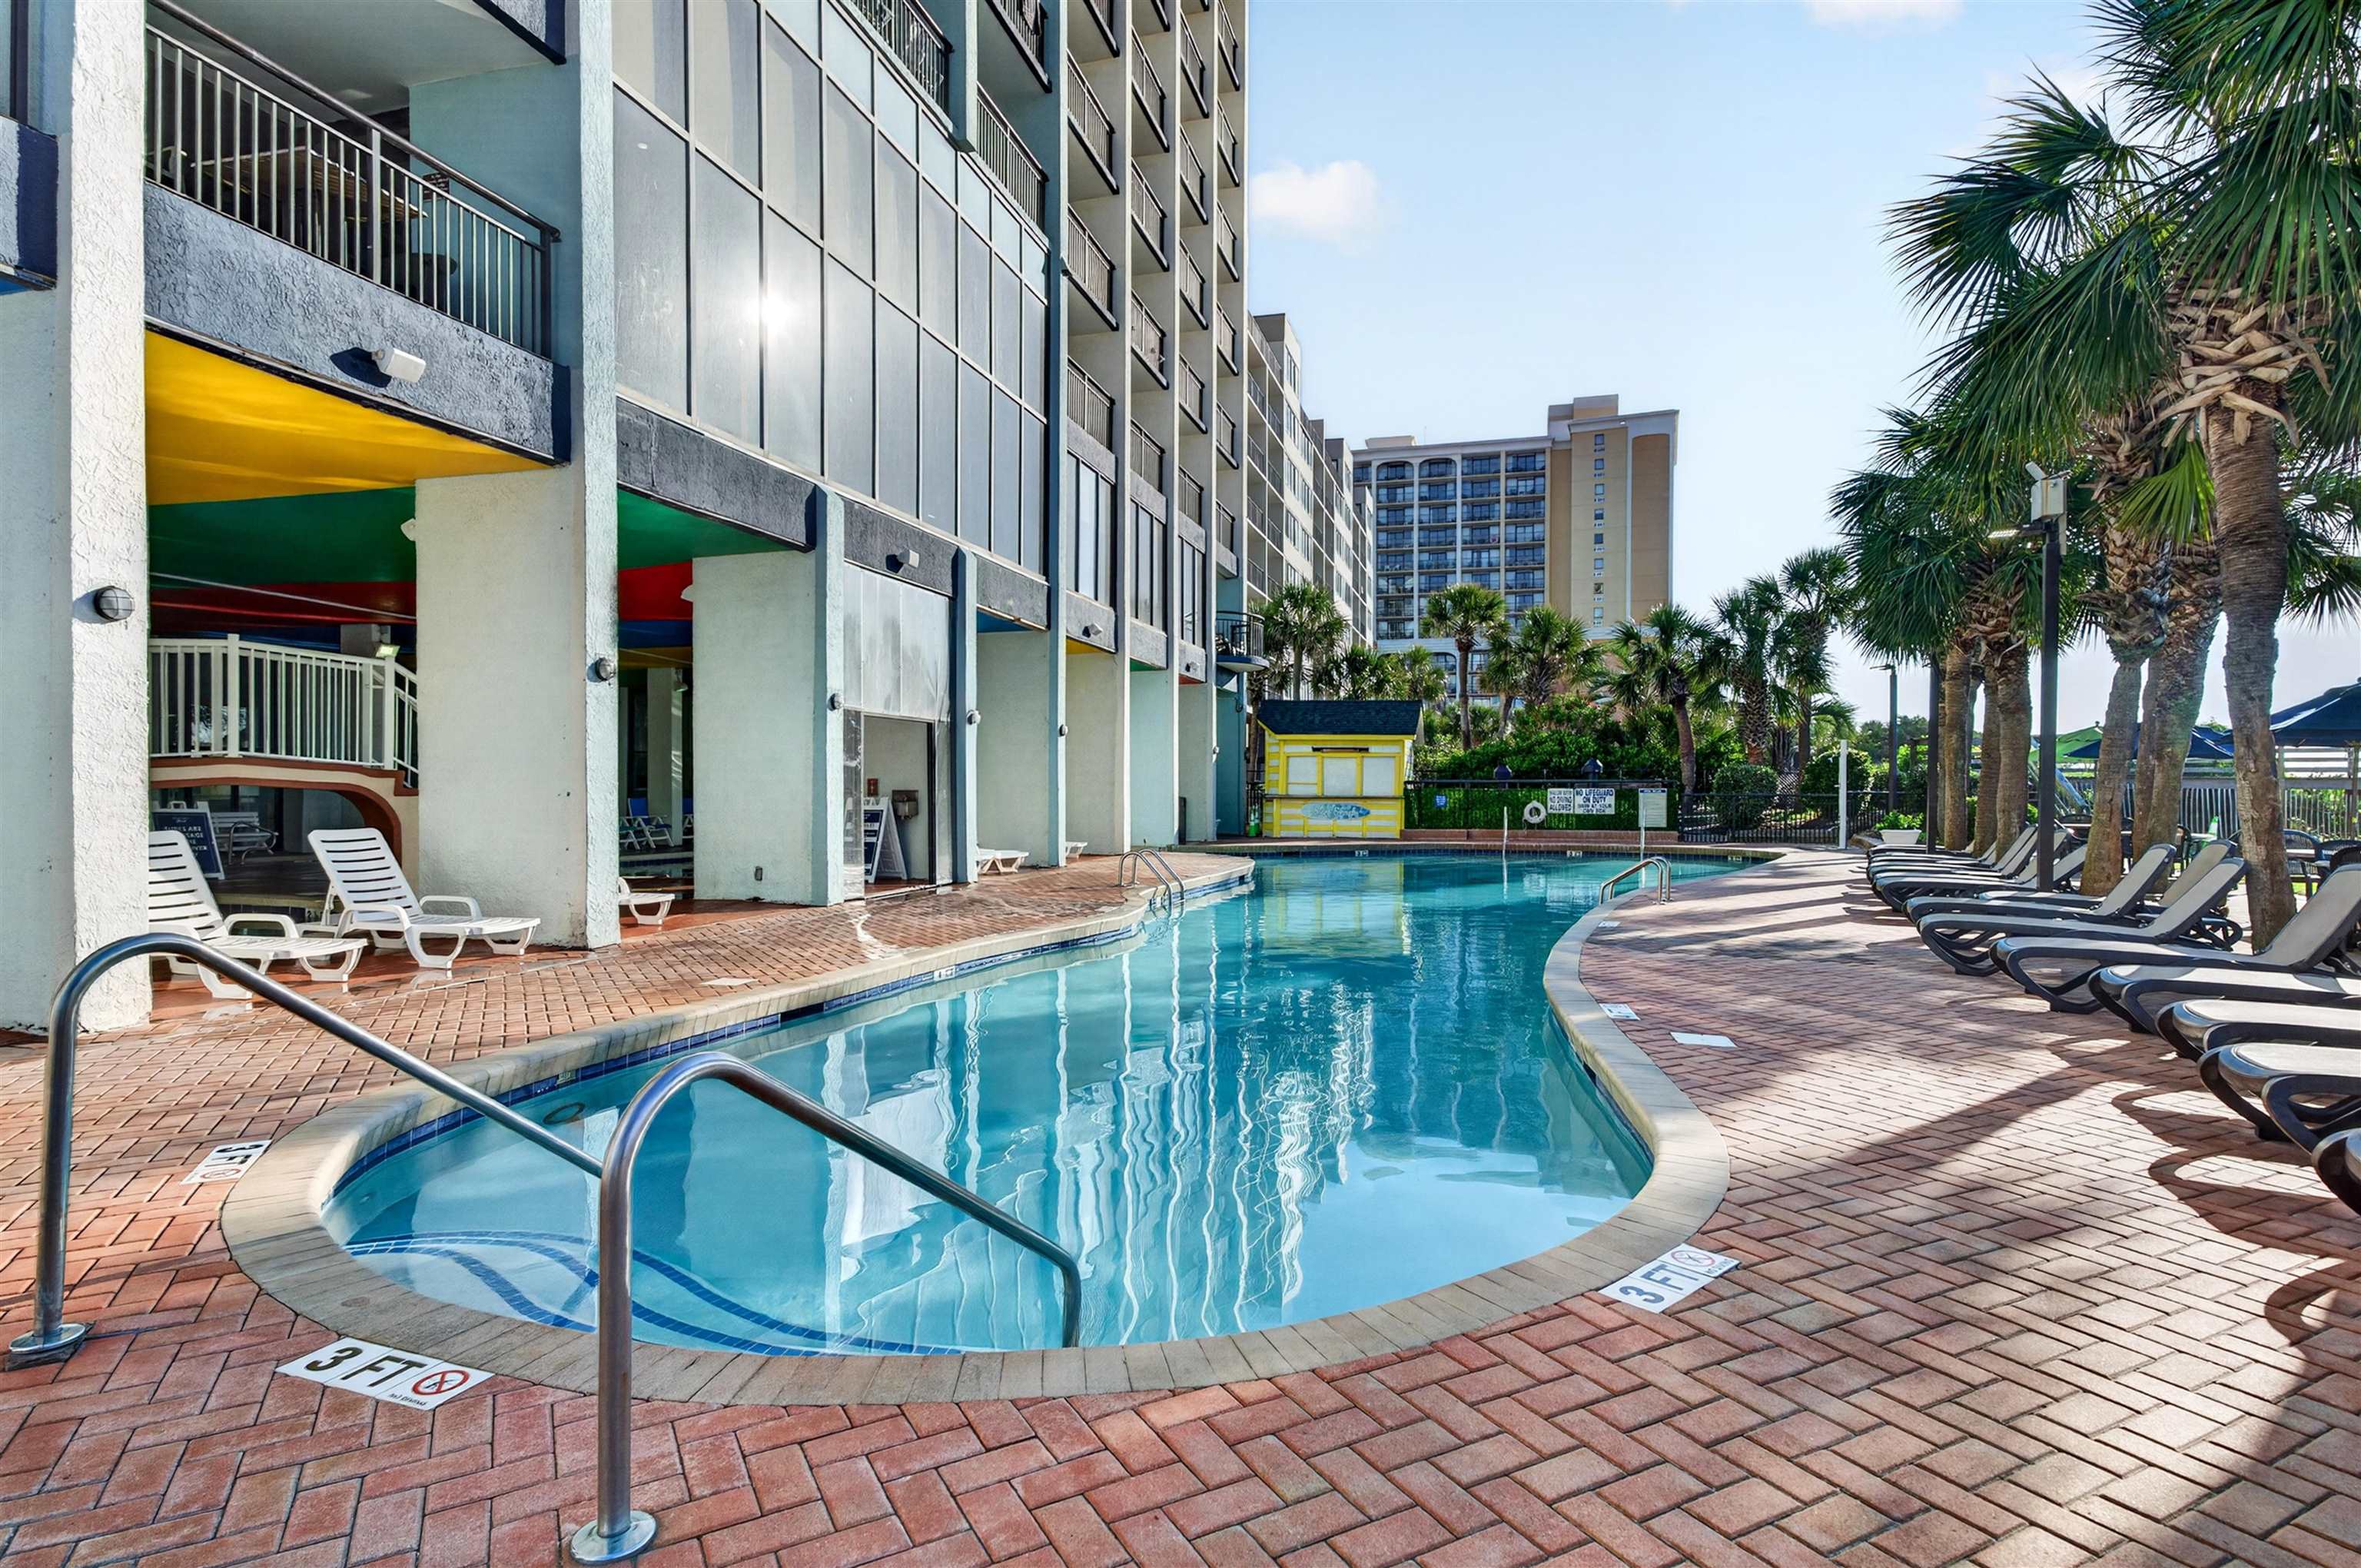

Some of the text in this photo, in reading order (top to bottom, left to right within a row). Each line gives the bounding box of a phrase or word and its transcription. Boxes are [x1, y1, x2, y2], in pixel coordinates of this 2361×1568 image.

[216, 1144, 264, 1153] 3
[1639, 1264, 1699, 1291] FT
[1619, 1285, 1665, 1304] 3
[304, 1347, 427, 1388] 3 FT
